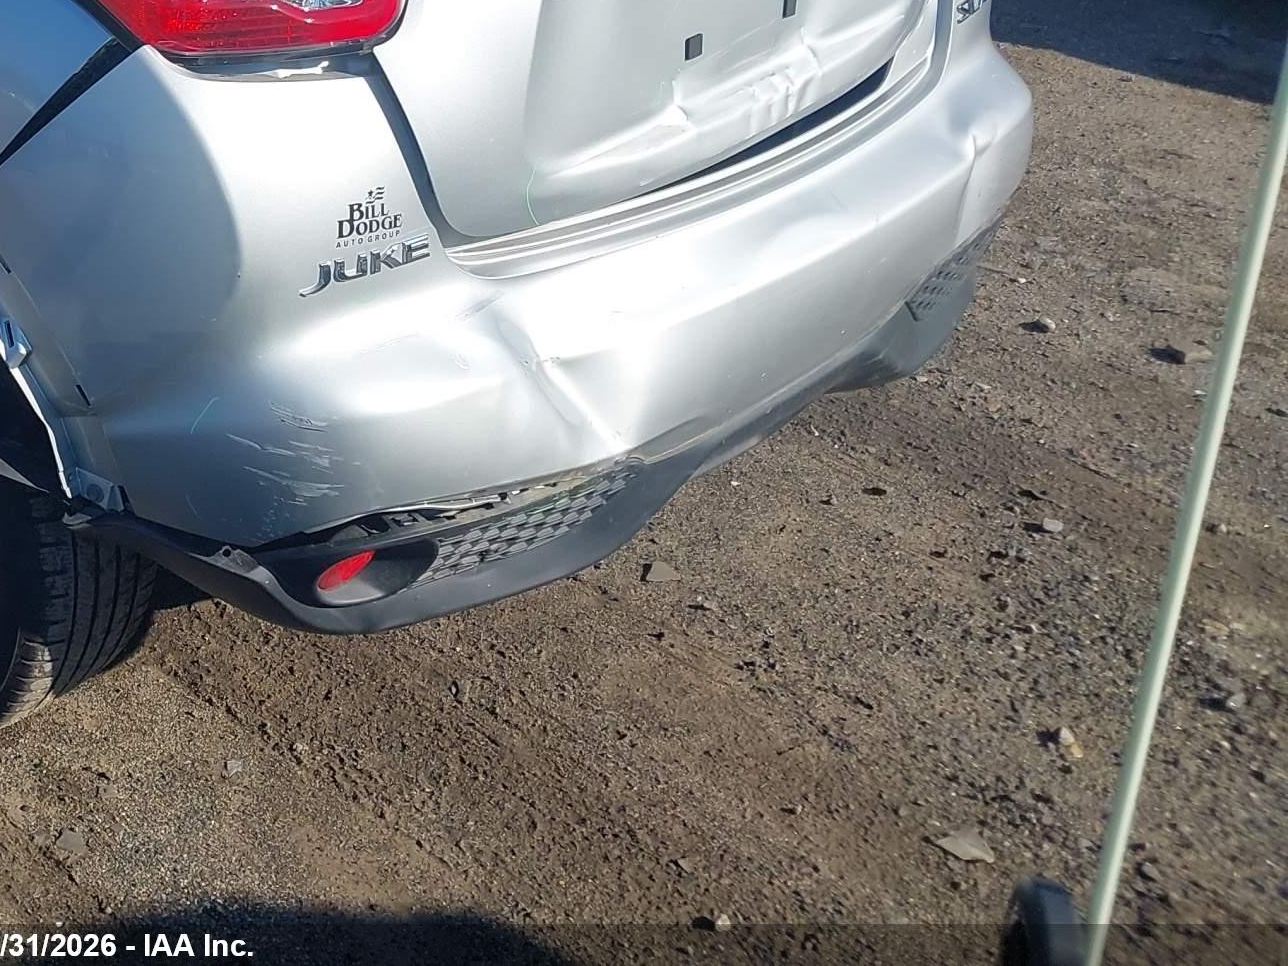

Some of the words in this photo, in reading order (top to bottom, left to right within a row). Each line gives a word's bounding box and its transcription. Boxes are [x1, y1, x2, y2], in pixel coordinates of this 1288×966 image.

[348, 202, 389, 222] BILL
[336, 213, 403, 239] DODGE
[335, 237, 364, 249] AUTO
[367, 229, 401, 243] GROUP
[298, 233, 431, 298] JUKE
